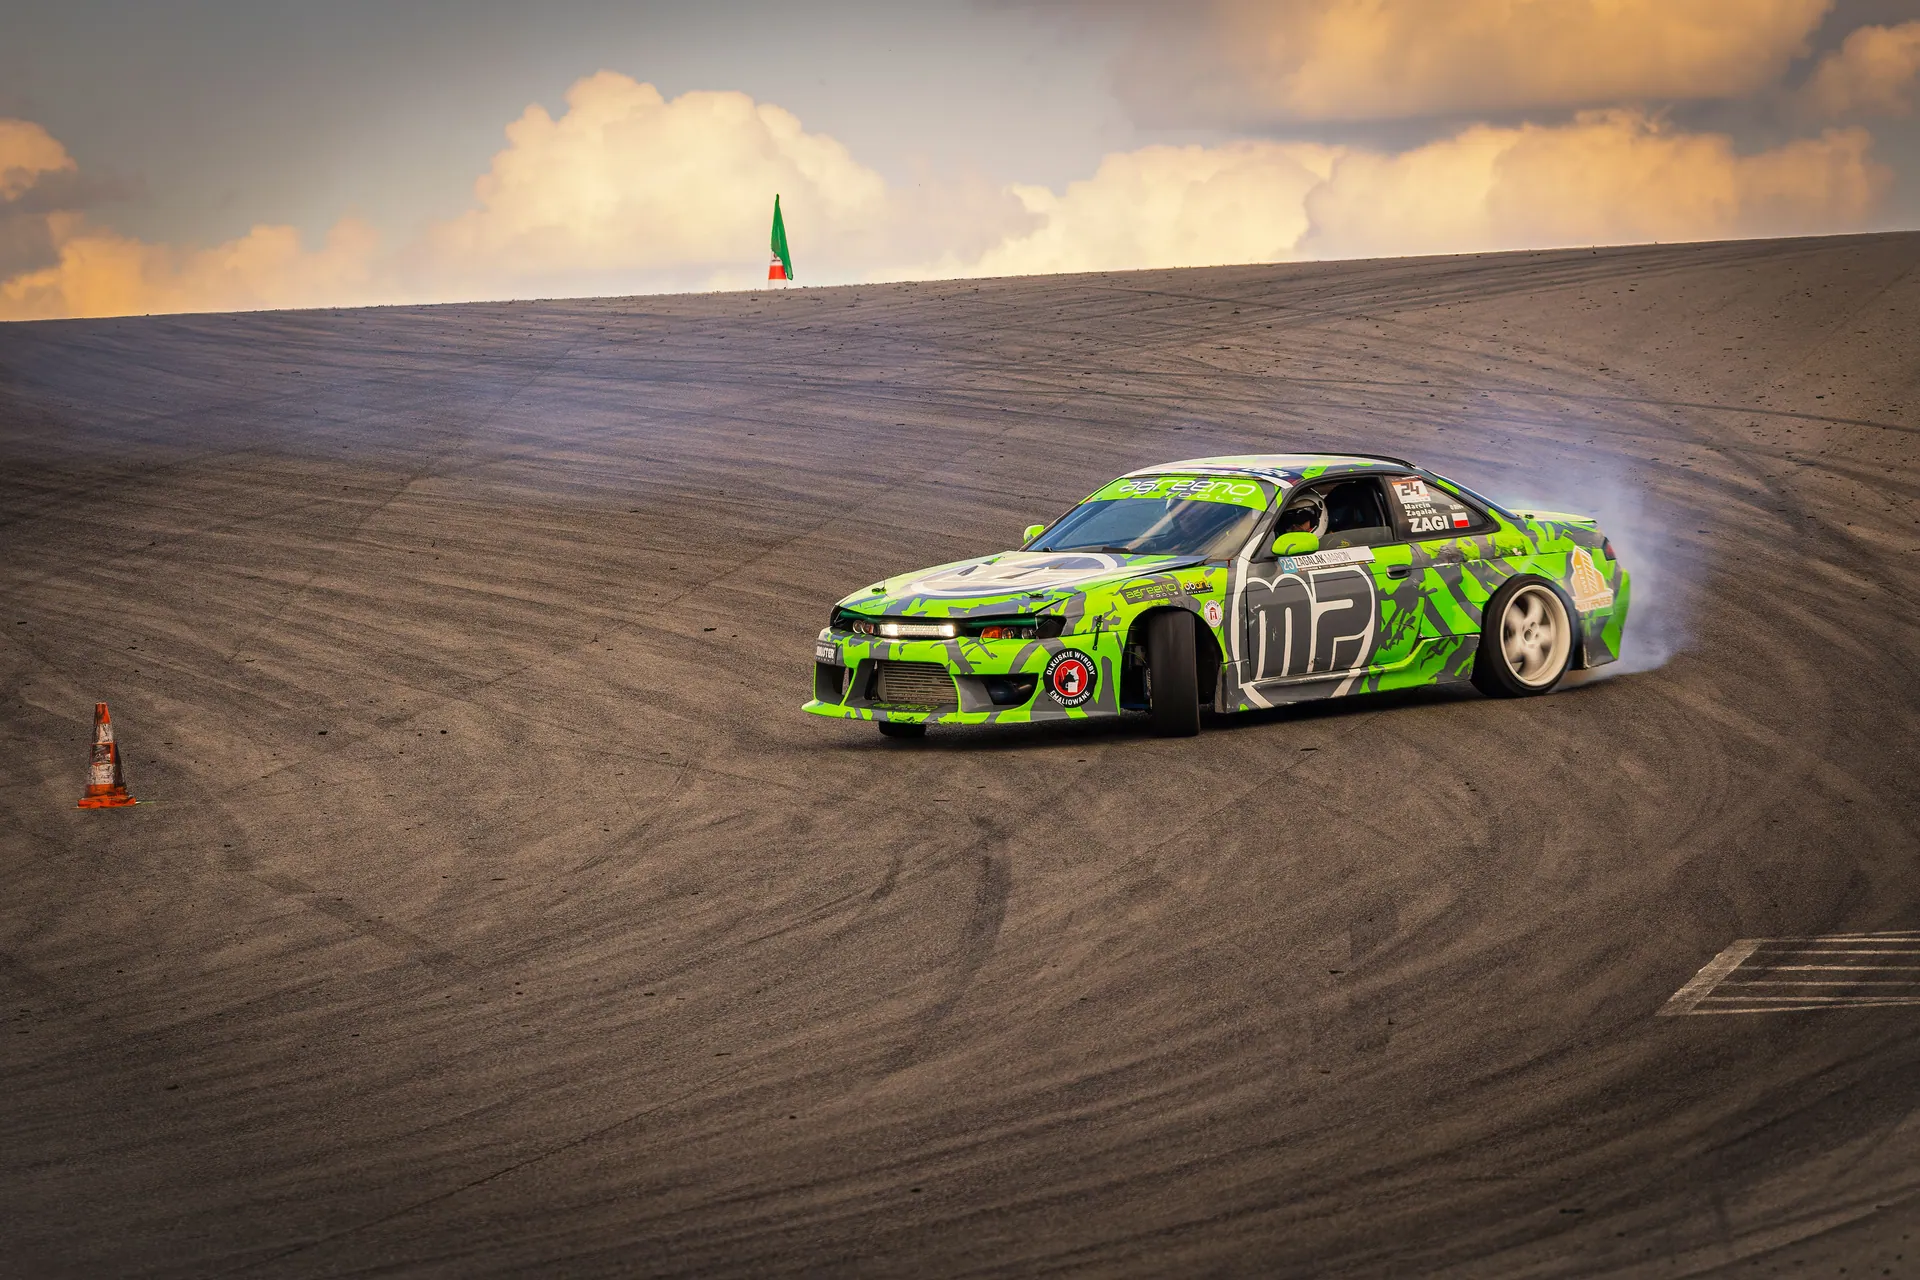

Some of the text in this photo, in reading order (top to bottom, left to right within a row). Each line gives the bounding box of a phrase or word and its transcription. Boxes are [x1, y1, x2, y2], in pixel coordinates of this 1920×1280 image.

[1119, 479, 1256, 496] agreeno
[1400, 482, 1420, 496] 24
[1165, 491, 1244, 503] TOOLS
[1403, 502, 1431, 510] Marcin
[1405, 508, 1437, 517] Zagalak
[1408, 515, 1450, 533] ZAGI
[1280, 559, 1295, 571] 25
[1293, 554, 1327, 567] ZAGALAK
[1323, 551, 1352, 563] MARCIN
[1575, 564, 1589, 594] INVEST
[1125, 583, 1177, 599] agreeno
[1046, 651, 1073, 676] OLKUSKIE
[1050, 690, 1091, 706] EMALIOWANE
